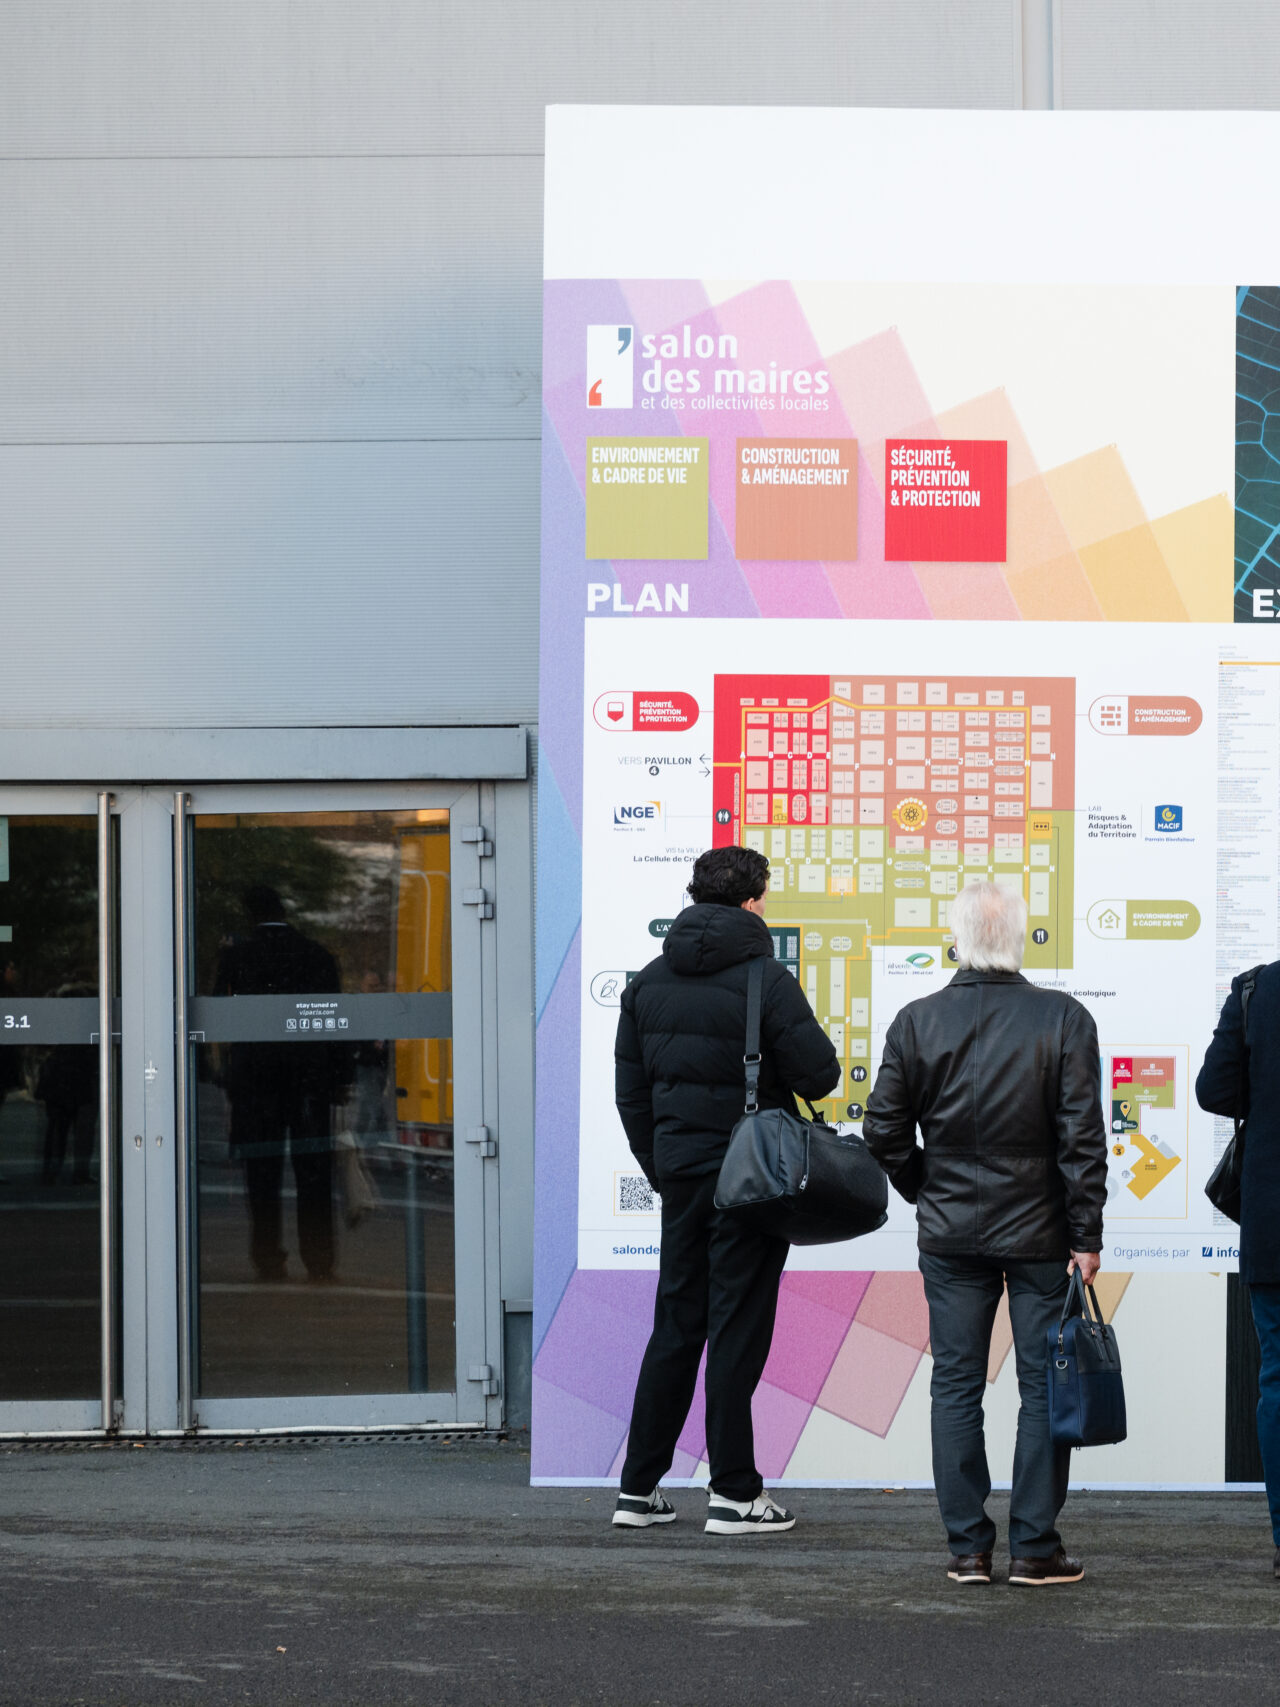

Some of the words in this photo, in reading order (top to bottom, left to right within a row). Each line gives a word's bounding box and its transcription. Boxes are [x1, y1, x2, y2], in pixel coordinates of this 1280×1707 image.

[642, 326, 739, 359] salon
[642, 361, 701, 393] des
[714, 362, 830, 394] maires
[641, 395, 656, 409] et
[661, 394, 685, 409] des
[691, 395, 774, 411] collectivités
[780, 395, 829, 411] locales
[591, 447, 700, 464] ENVIRONNEMENT
[741, 447, 840, 465] CONSTRUCTION
[890, 446, 957, 468] SÉCURITÉ,
[592, 467, 601, 484] &
[603, 467, 646, 484] CADRE
[648, 467, 664, 484] DE
[666, 467, 687, 484] VIE
[741, 468, 751, 484] &
[753, 465, 850, 486] AMÉNAGEMENT
[890, 467, 970, 487] PRÉVENTION
[890, 489, 900, 506] &
[902, 489, 981, 507] PROTECTION
[587, 583, 689, 612] PLAN
[644, 757, 692, 765] PAVILLON
[620, 806, 655, 818] NGE
[1088, 814, 1119, 822] Risques
[1088, 822, 1132, 830] Adaptation
[1073, 989, 1116, 998] écologique
[4, 1015, 31, 1029] 3.1
[1114, 1247, 1168, 1260] Organisés
[1172, 1249, 1189, 1260] par
